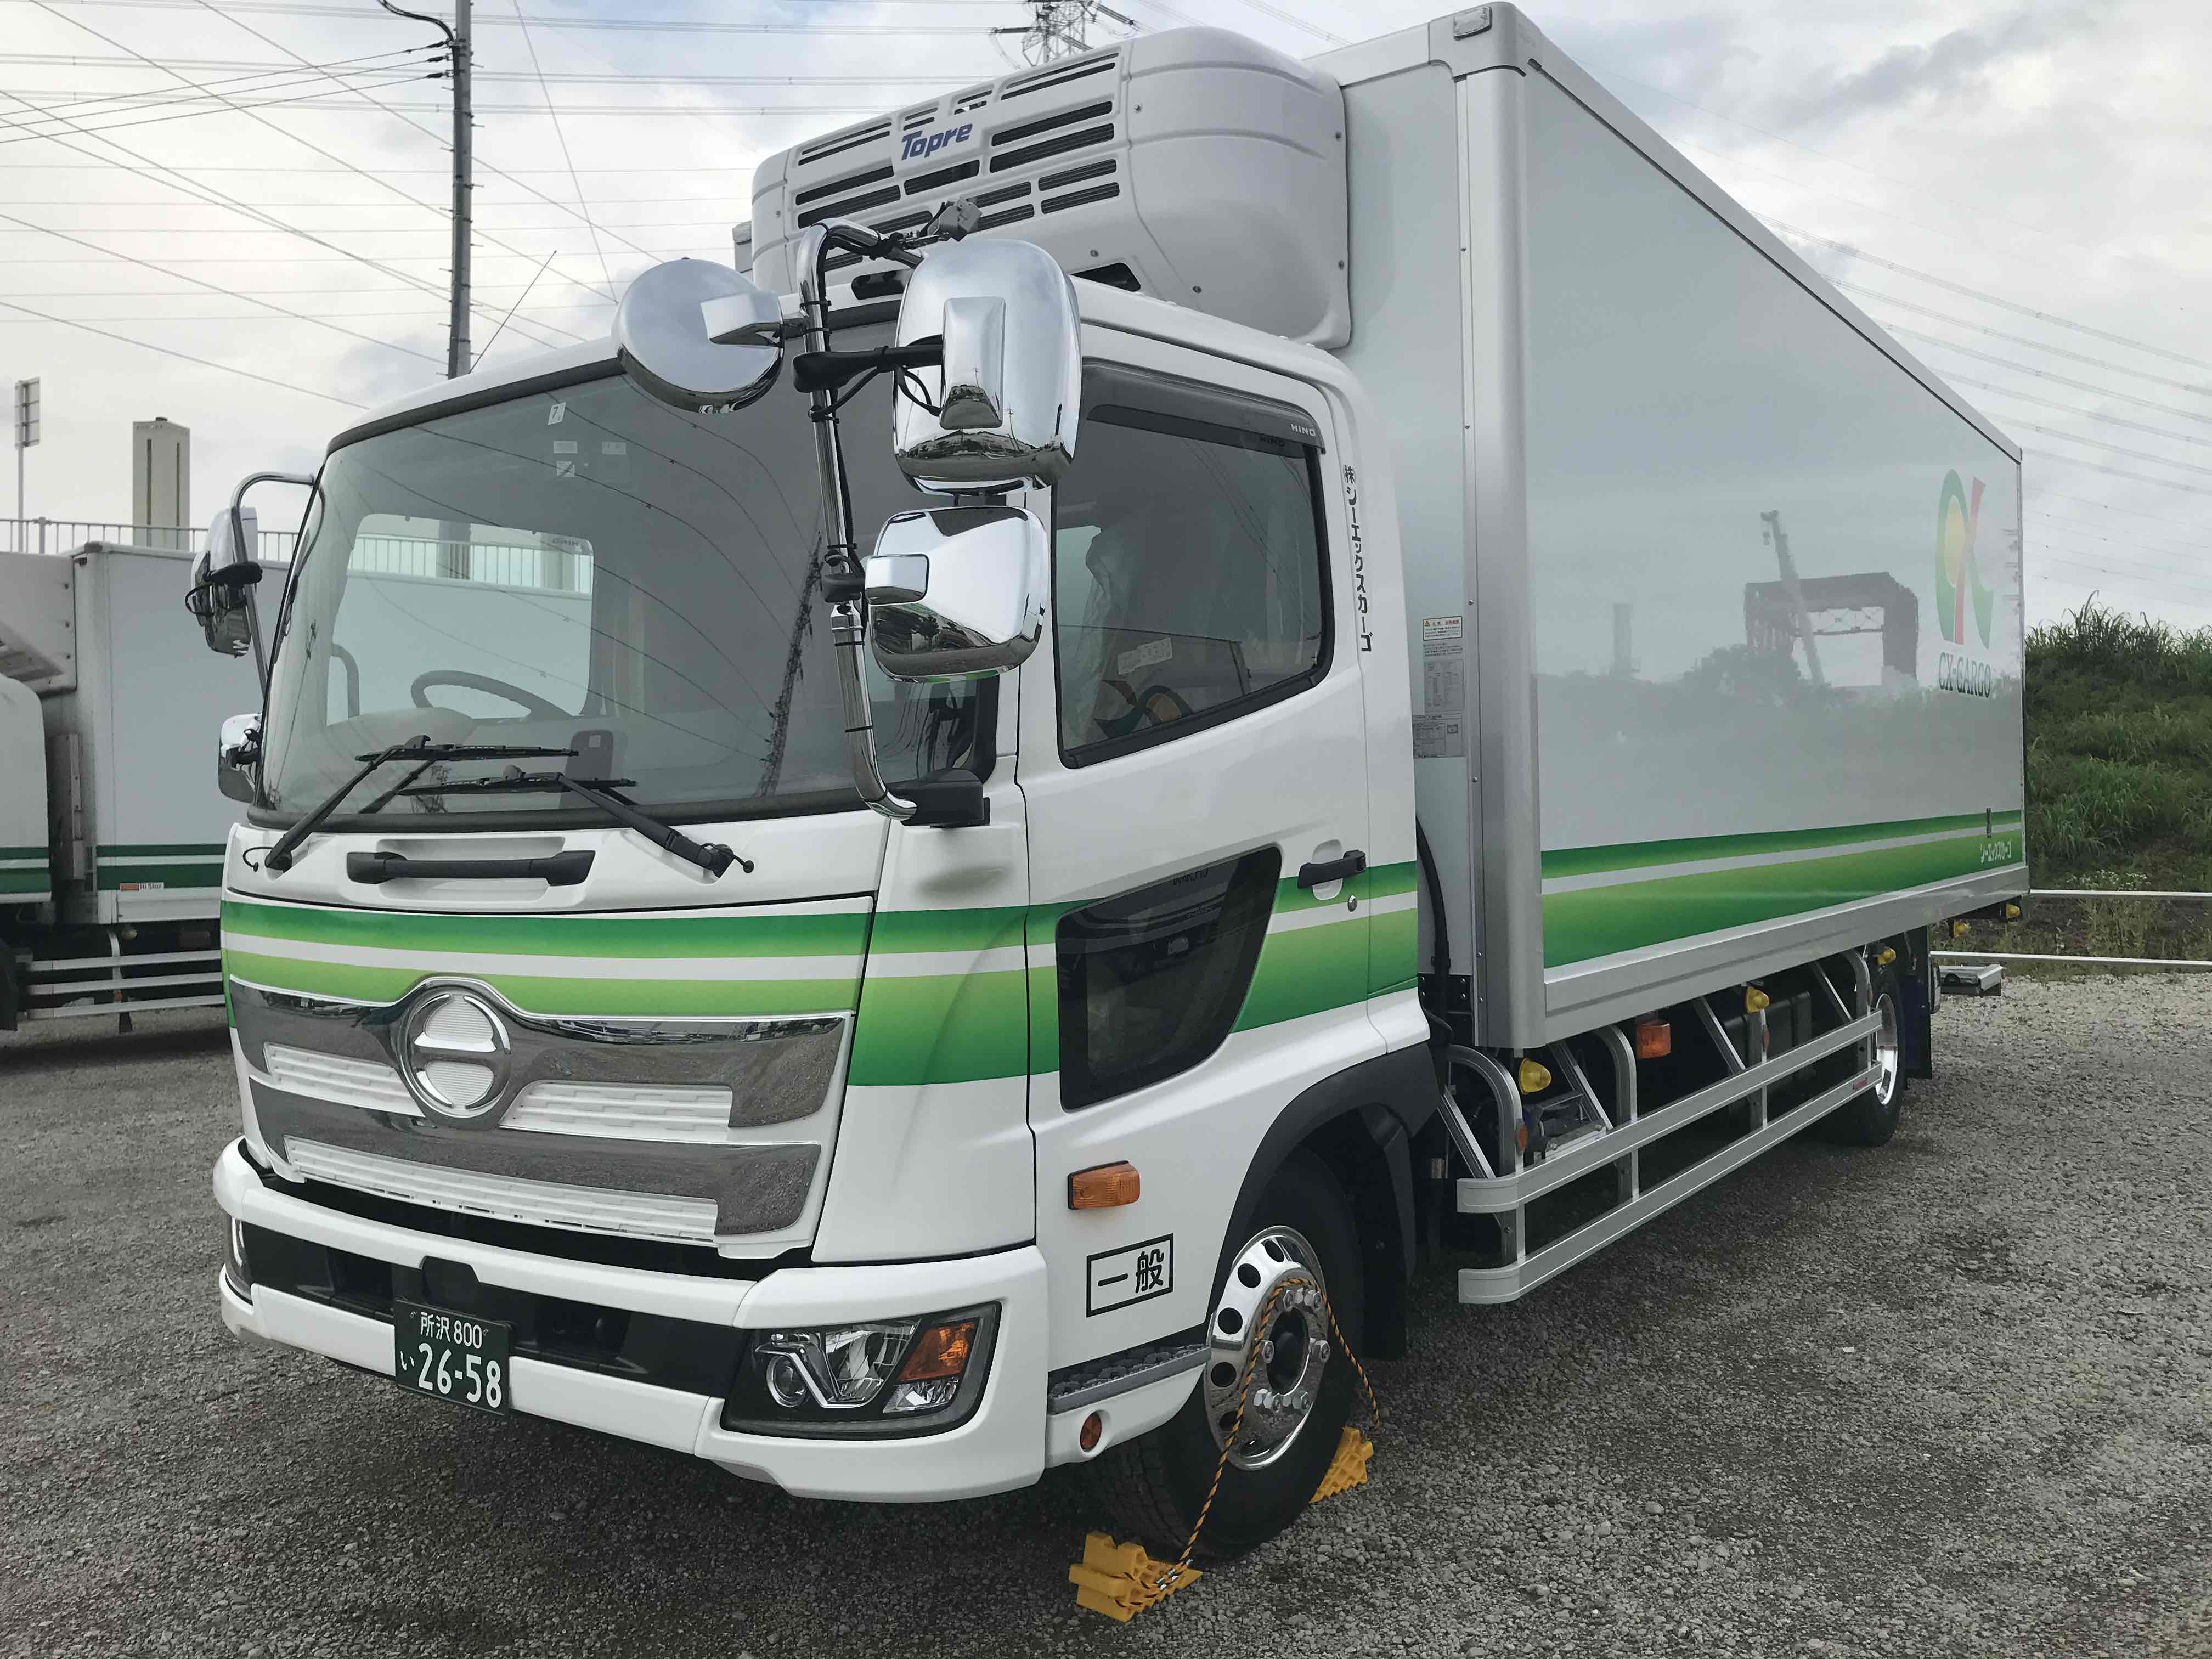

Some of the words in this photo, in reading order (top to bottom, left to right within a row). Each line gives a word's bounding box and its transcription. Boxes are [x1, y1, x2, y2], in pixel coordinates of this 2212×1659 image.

[901, 123, 973, 161] Topre
[1290, 424, 1316, 437] HINO
[1098, 1249, 1164, 1294] 一般
[420, 1312, 451, 1342] 所沢
[454, 1320, 482, 1349] 800
[400, 1351, 415, 1370] い
[419, 1343, 501, 1408] 26-58
